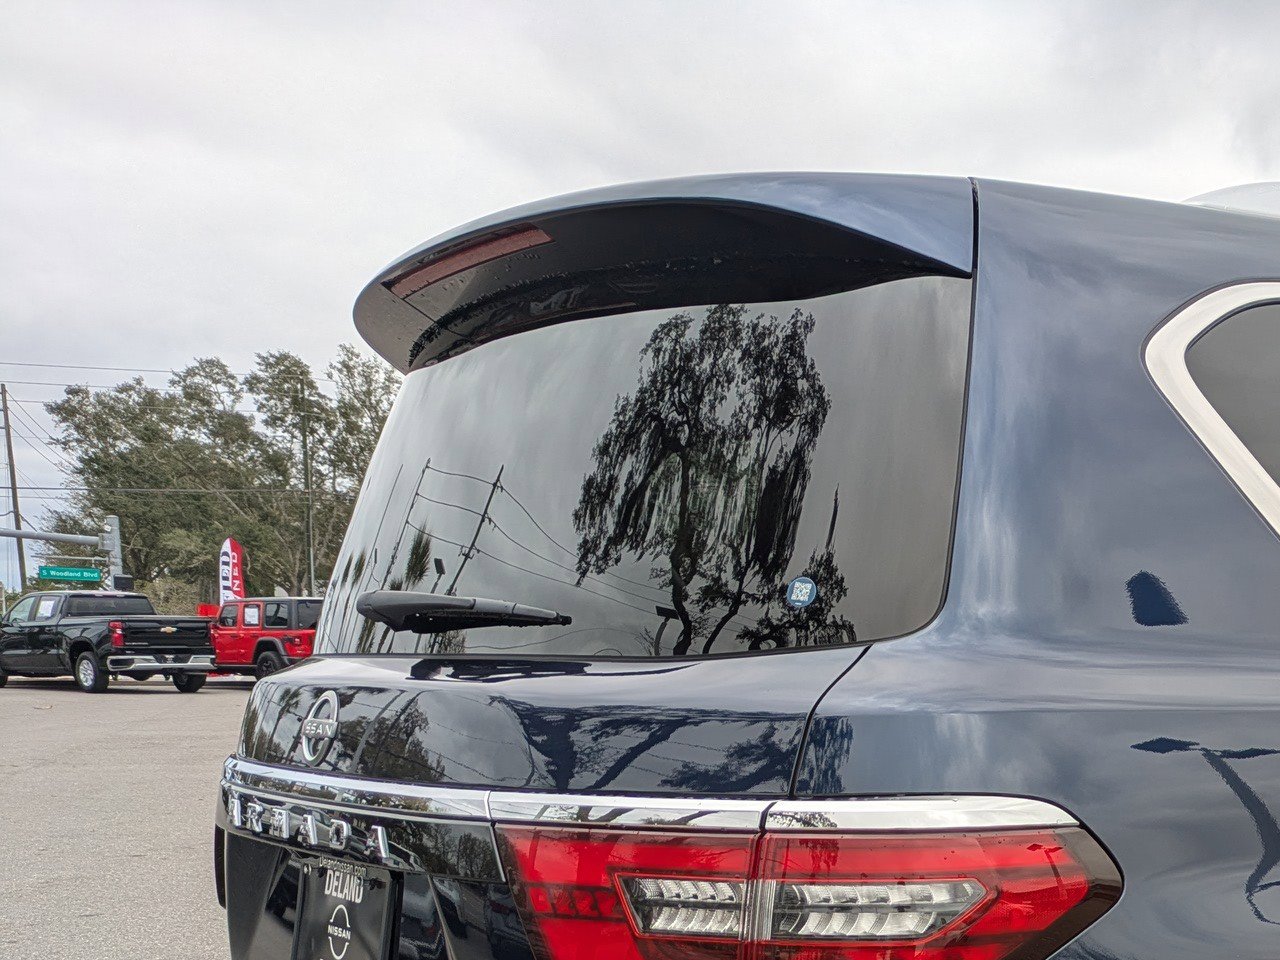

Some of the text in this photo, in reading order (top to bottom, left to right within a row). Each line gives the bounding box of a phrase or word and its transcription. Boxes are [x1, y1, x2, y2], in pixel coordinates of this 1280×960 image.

[228, 798, 390, 861] ARMADA
[324, 869, 364, 904] DELAND
[328, 924, 351, 940] NISSAN
